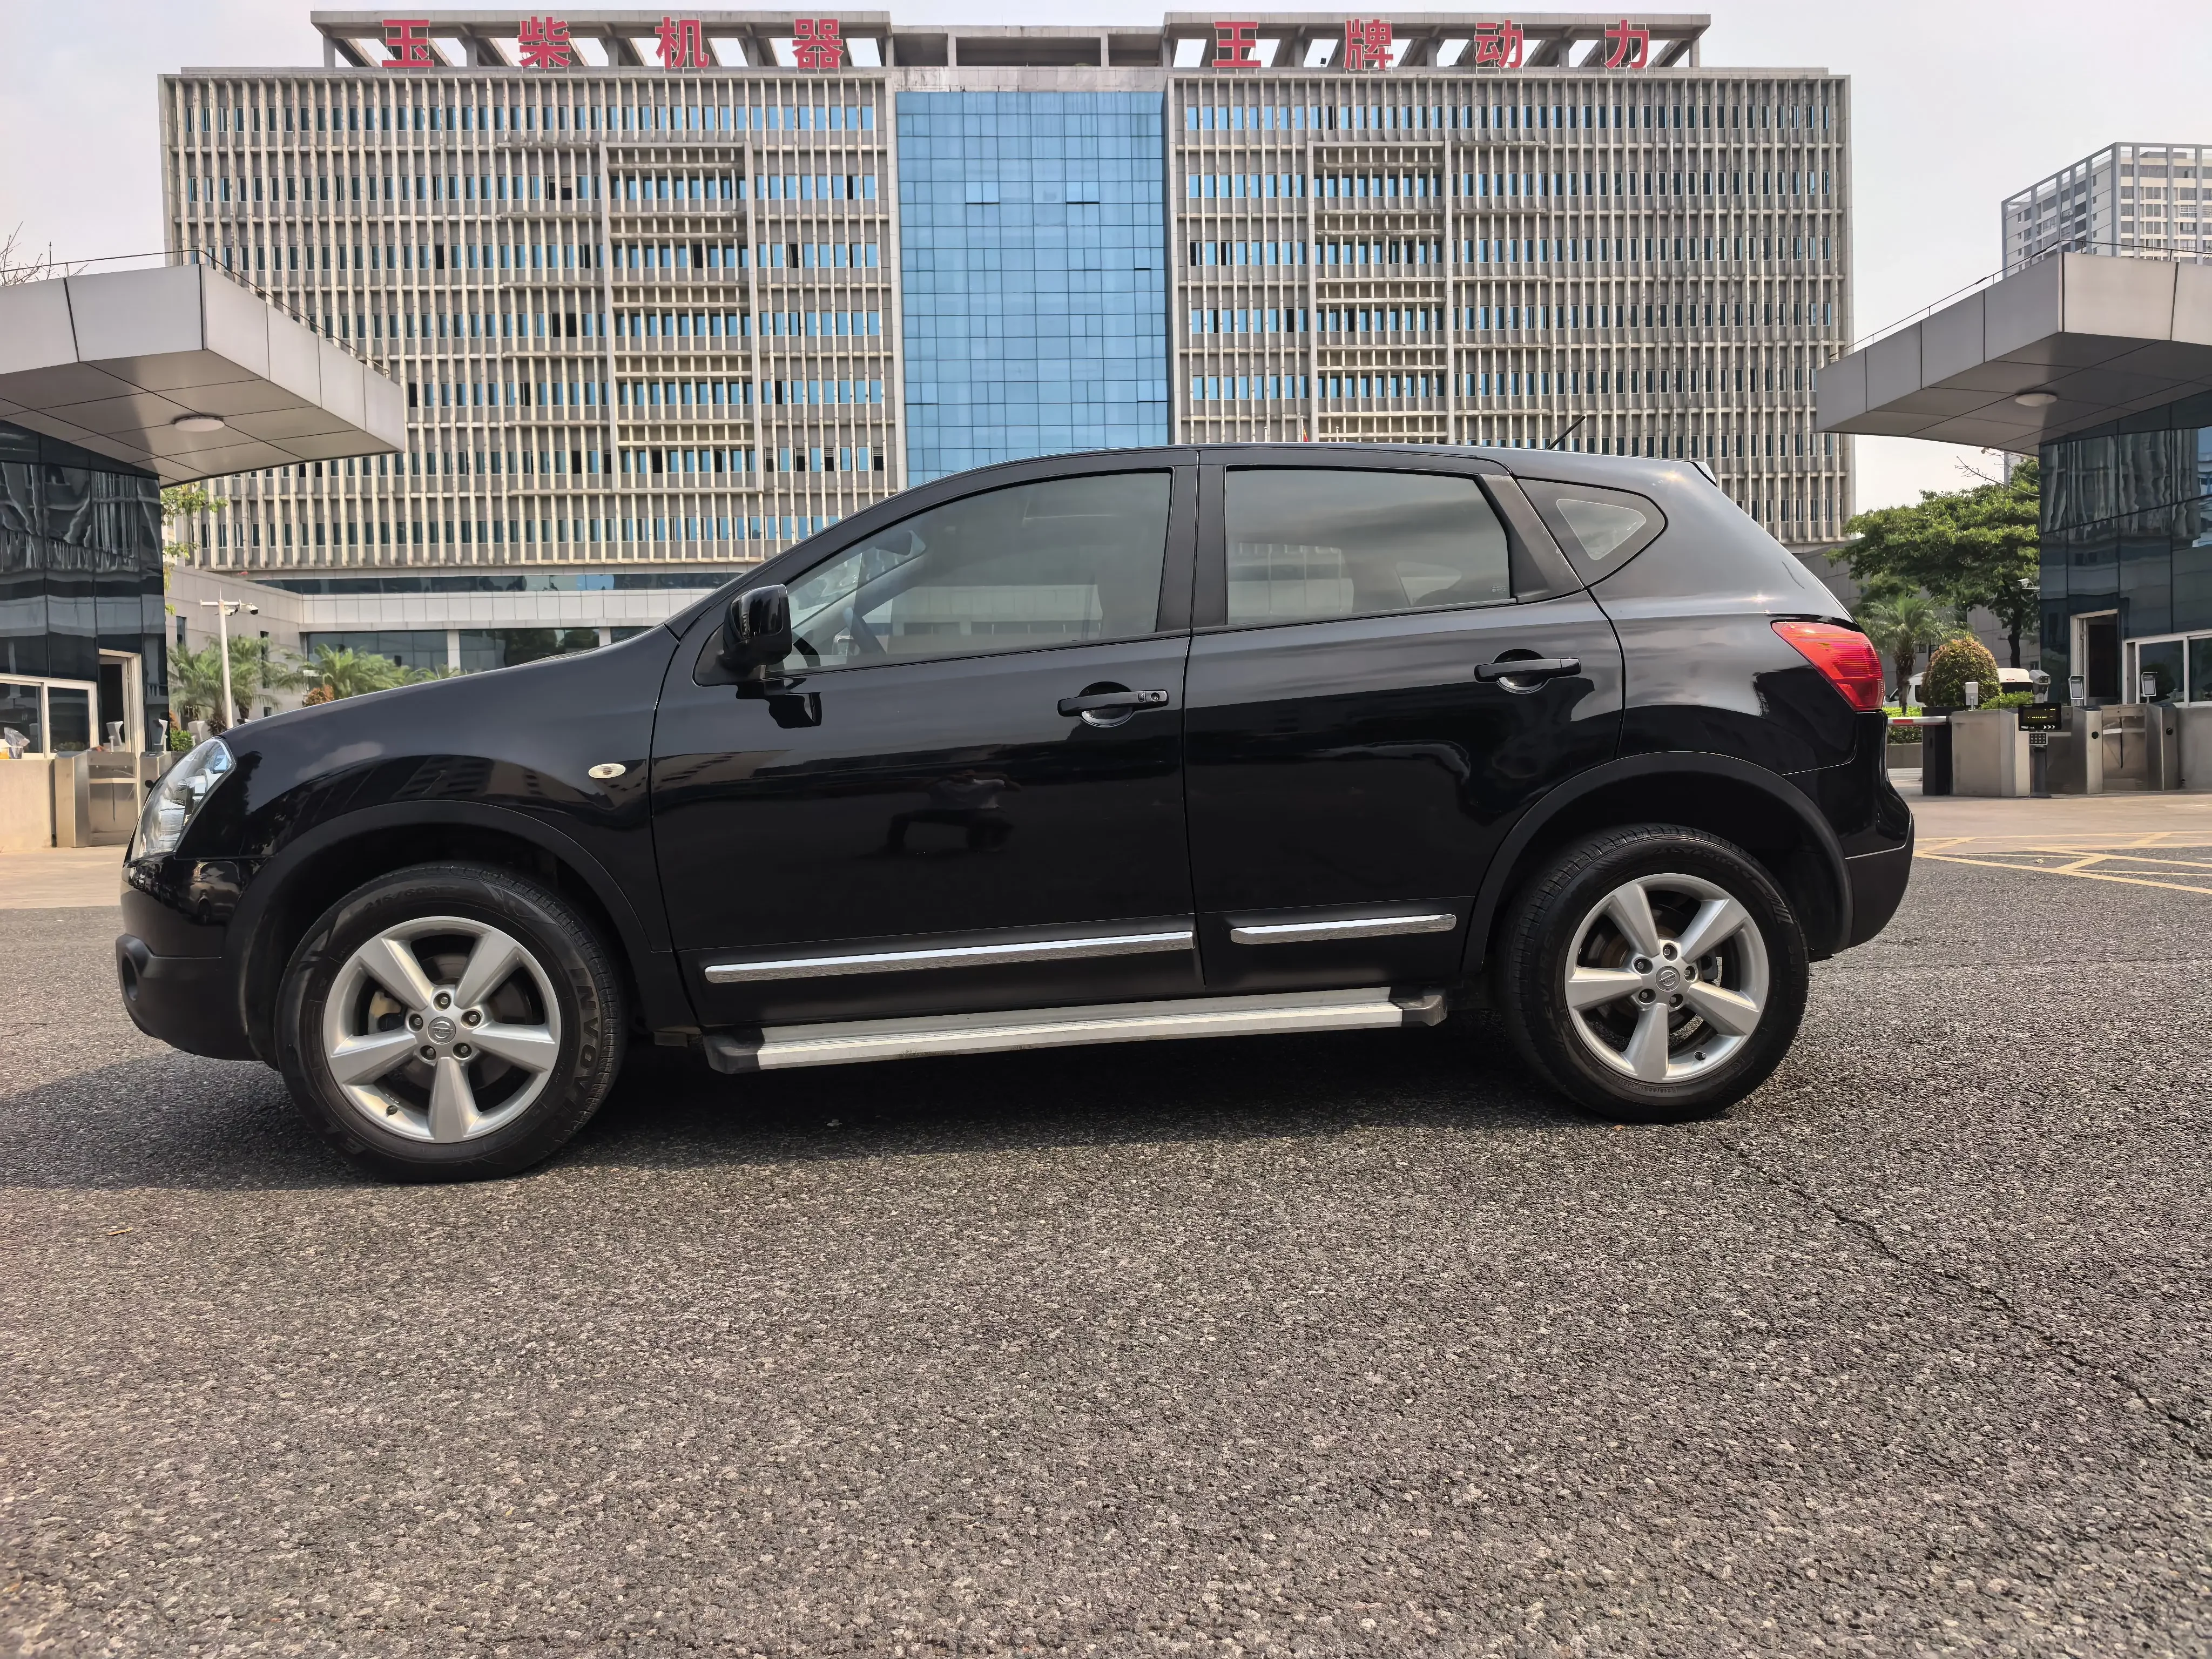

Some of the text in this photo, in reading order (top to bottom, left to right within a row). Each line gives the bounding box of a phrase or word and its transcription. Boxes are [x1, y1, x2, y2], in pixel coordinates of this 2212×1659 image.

[381, 16, 1649, 70] 玉柴机器 王牌动力
[554, 968, 598, 1122] INVOVI
